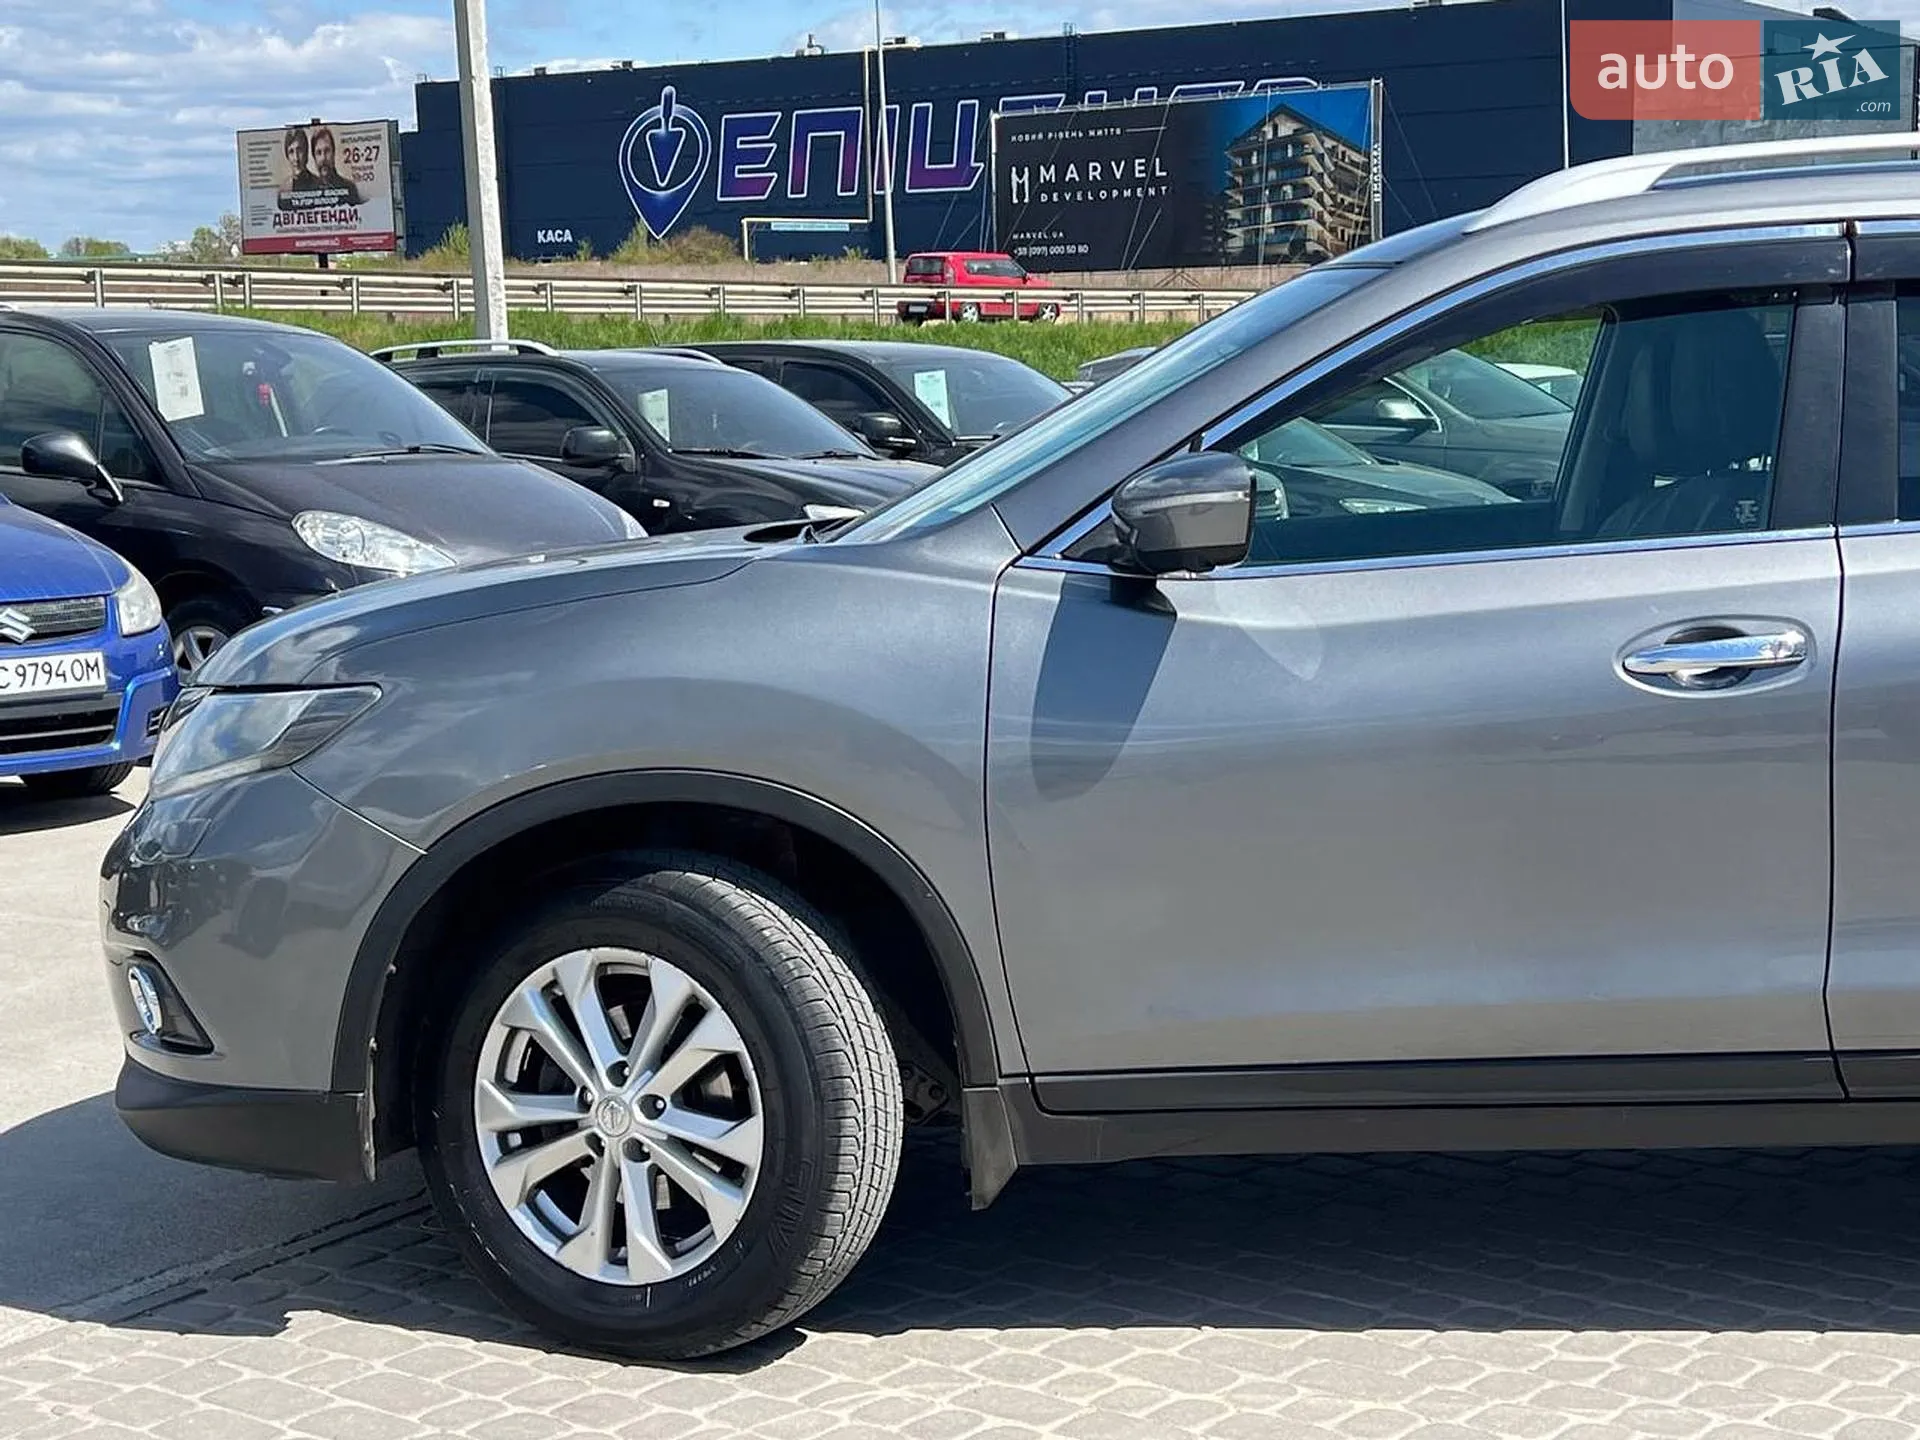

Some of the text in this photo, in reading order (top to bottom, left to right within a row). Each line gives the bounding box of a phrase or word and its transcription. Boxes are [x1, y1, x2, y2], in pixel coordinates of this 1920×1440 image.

[717, 78, 1321, 201] ЕПІЦ
[1040, 157, 1167, 183] MARVEL
[1040, 185, 1168, 202] DEVELOPMENT
[273, 213, 294, 228] ДВІ
[537, 229, 573, 243] КАСА
